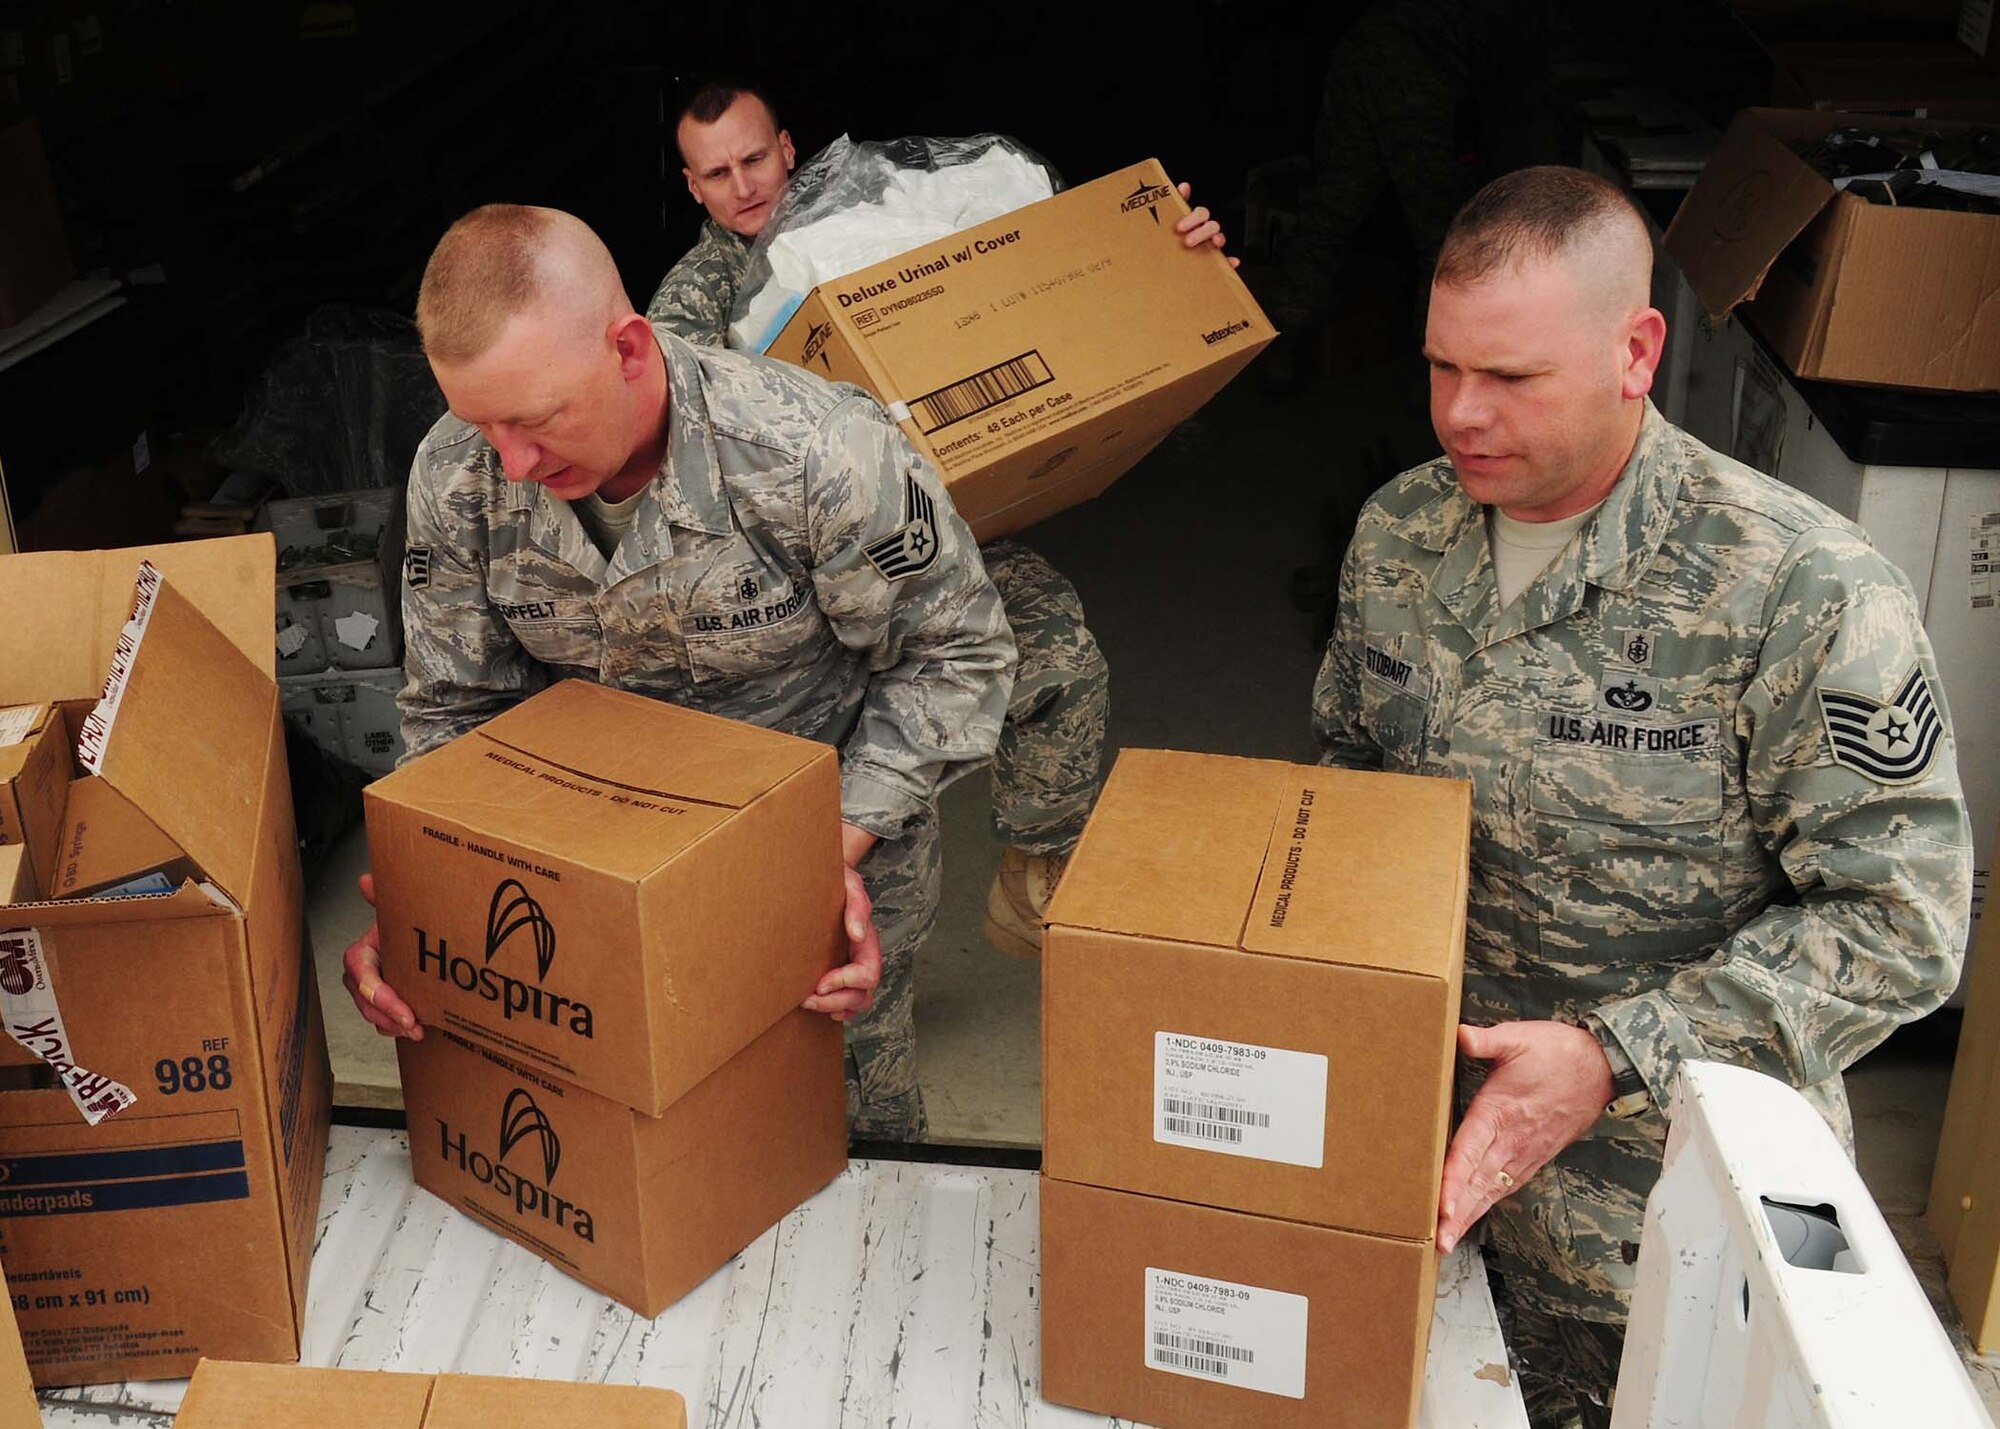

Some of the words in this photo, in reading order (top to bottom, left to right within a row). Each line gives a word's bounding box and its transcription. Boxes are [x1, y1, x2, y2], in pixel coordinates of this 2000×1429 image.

[1120, 185, 1171, 213] MEDLINE
[837, 277, 898, 308] Deluxe
[898, 255, 950, 285] Urinal
[952, 248, 973, 264] w/
[974, 229, 1021, 255] Cover
[855, 312, 875, 325] REF
[880, 285, 945, 317] DYND80235SD
[801, 321, 832, 366] MEDLINE
[932, 430, 984, 458] Contents:
[987, 422, 1000, 435] 48
[1000, 411, 1028, 430] Each
[1029, 404, 1046, 420] per
[1046, 391, 1073, 409] Case
[694, 616, 727, 631] U.S.
[732, 608, 762, 629] AIR
[1367, 646, 1413, 687] STOBART
[364, 731, 393, 740] LABEL
[364, 738, 395, 747] OTHER
[1550, 715, 1584, 742] U.S.
[1590, 721, 1627, 748] AIR
[1634, 724, 1705, 751] FORCE
[485, 751, 536, 775] MEDICAL
[538, 773, 602, 797] PRODUCTS
[610, 795, 628, 804] DO
[631, 800, 658, 810] NOT
[659, 806, 687, 816] CUT
[1301, 789, 1316, 806] CUT
[1293, 827, 1306, 840] DO
[1297, 808, 1311, 825] NOT
[423, 826, 459, 847] FRAGILE
[468, 842, 504, 862] HANDLE
[507, 855, 532, 872] WITH
[535, 865, 561, 882] CARE
[1280, 846, 1302, 890] PRODUCTS
[1270, 893, 1291, 928] MEDICAL
[413, 927, 593, 1039] Hospira
[202, 1037, 229, 1052] REF
[1166, 1037, 1197, 1050] 1-NDC
[1200, 1042, 1266, 1060] 0409-7983-09
[155, 1054, 232, 1095] 988
[443, 1030, 475, 1053] FRAGILE
[481, 1050, 515, 1075] HANDLE
[517, 1067, 540, 1085] WITH
[541, 1079, 564, 1098] CARE
[1181, 1060, 1207, 1071] SODIUM
[1207, 1065, 1240, 1077] CHLORIDE
[436, 1118, 595, 1243] Hospira
[35, 1294, 63, 1309] cm
[69, 1293, 80, 1307] x
[84, 1289, 107, 1306] 91
[114, 1285, 150, 1304] cm)
[1155, 1275, 1184, 1288] 1-NDC
[1188, 1282, 1250, 1301] 0409-7983-09
[1195, 1302, 1225, 1315] CHLORIDE
